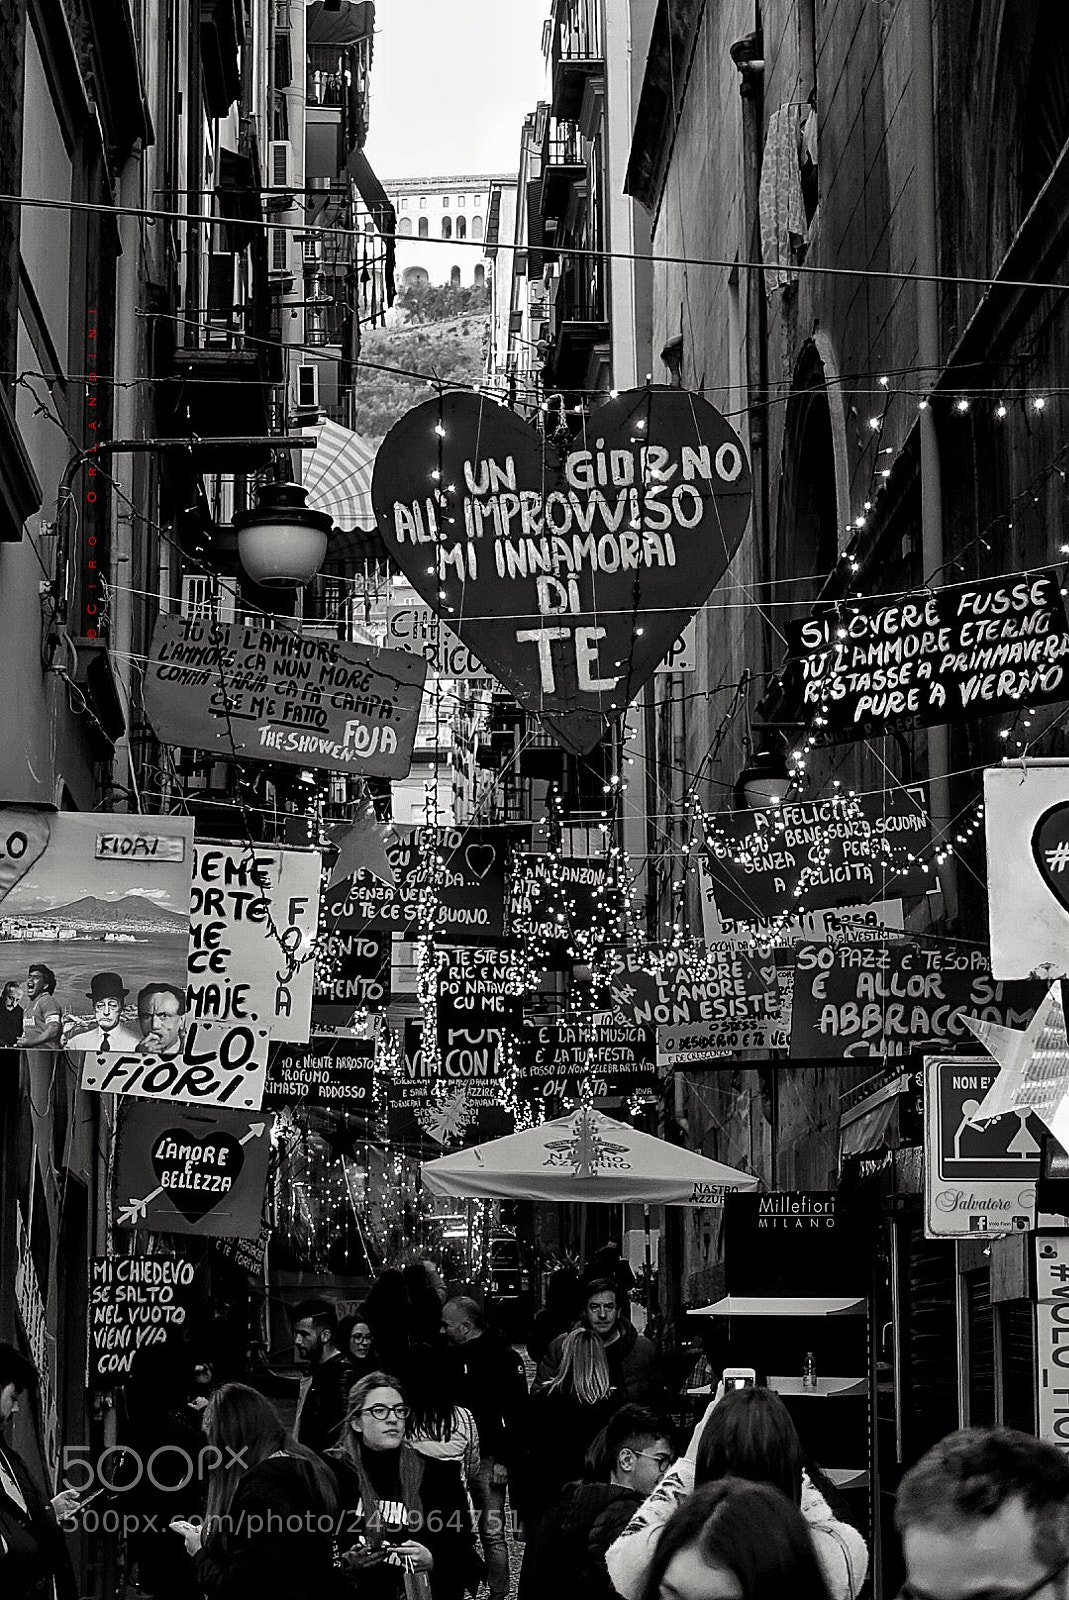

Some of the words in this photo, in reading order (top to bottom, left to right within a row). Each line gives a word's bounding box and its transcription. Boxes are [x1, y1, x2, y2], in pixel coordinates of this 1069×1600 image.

[464, 456, 516, 494] UN
[464, 485, 703, 537] IMPROVVISO
[440, 542, 477, 582] MI
[495, 532, 676, 578] INNAMORAI
[801, 620, 829, 648] SI
[957, 580, 1050, 616] FUSSE
[180, 620, 203, 642] TU
[800, 653, 827, 680] TU
[834, 628, 952, 672] L'AMMORE
[960, 611, 1051, 646] ETERNO
[517, 627, 619, 693] TE
[272, 660, 310, 678] NUN
[320, 665, 374, 692] MORE
[804, 663, 912, 703] RESTASSE
[274, 679, 299, 696] CA
[854, 689, 920, 722] PURE
[958, 665, 1063, 708] VIERNO
[210, 694, 242, 710] CHE
[283, 702, 328, 726] FATTO
[343, 720, 398, 757] FOJA
[754, 813, 769, 830] A
[99, 836, 159, 856] FIORI
[785, 826, 823, 847] BENE
[744, 851, 796, 874] SENZA
[350, 888, 393, 900] SENZA
[774, 878, 785, 893] A
[331, 903, 354, 916] CU
[359, 902, 376, 918] TE
[381, 905, 400, 918] CE
[452, 950, 470, 965] TE
[659, 979, 746, 1003] L'AMORE
[812, 972, 830, 999] E
[856, 972, 945, 1001] ALLOR
[970, 976, 1003, 1004] SI
[454, 996, 475, 1009] CU
[634, 1000, 690, 1024] NON
[700, 991, 780, 1019] ESISTE
[558, 1028, 576, 1042] LA
[601, 1028, 646, 1042] MUSICA
[666, 1038, 674, 1050] O
[743, 1034, 749, 1047] E
[304, 1053, 333, 1069] NIENTE
[336, 1057, 374, 1070] ARROSTO
[445, 1049, 488, 1077] CON
[553, 1049, 570, 1062] LA
[598, 1047, 634, 1061] FESTA
[101, 1056, 244, 1103] FIORI
[530, 1065, 555, 1076] POSSO
[319, 1086, 366, 1098] ADDOSSO
[543, 1079, 567, 1098] OH
[952, 1076, 978, 1089] NON
[981, 1076, 990, 1089] E'
[155, 1137, 229, 1166] L'AMORE
[161, 1171, 231, 1191] BELLEZZA
[759, 1196, 835, 1213] Millefiori
[935, 1188, 1012, 1212] Salvatore
[758, 1218, 834, 1228] MILANO
[93, 1262, 113, 1283] MI
[117, 1256, 194, 1284] CHIEDEVO
[92, 1286, 110, 1303] SE
[116, 1286, 174, 1303] SALTO
[95, 1306, 123, 1325] NEL
[128, 1306, 186, 1325] VUOTO
[94, 1324, 132, 1349] VIENI
[136, 1327, 167, 1349] VIA
[98, 1351, 136, 1373] CON
